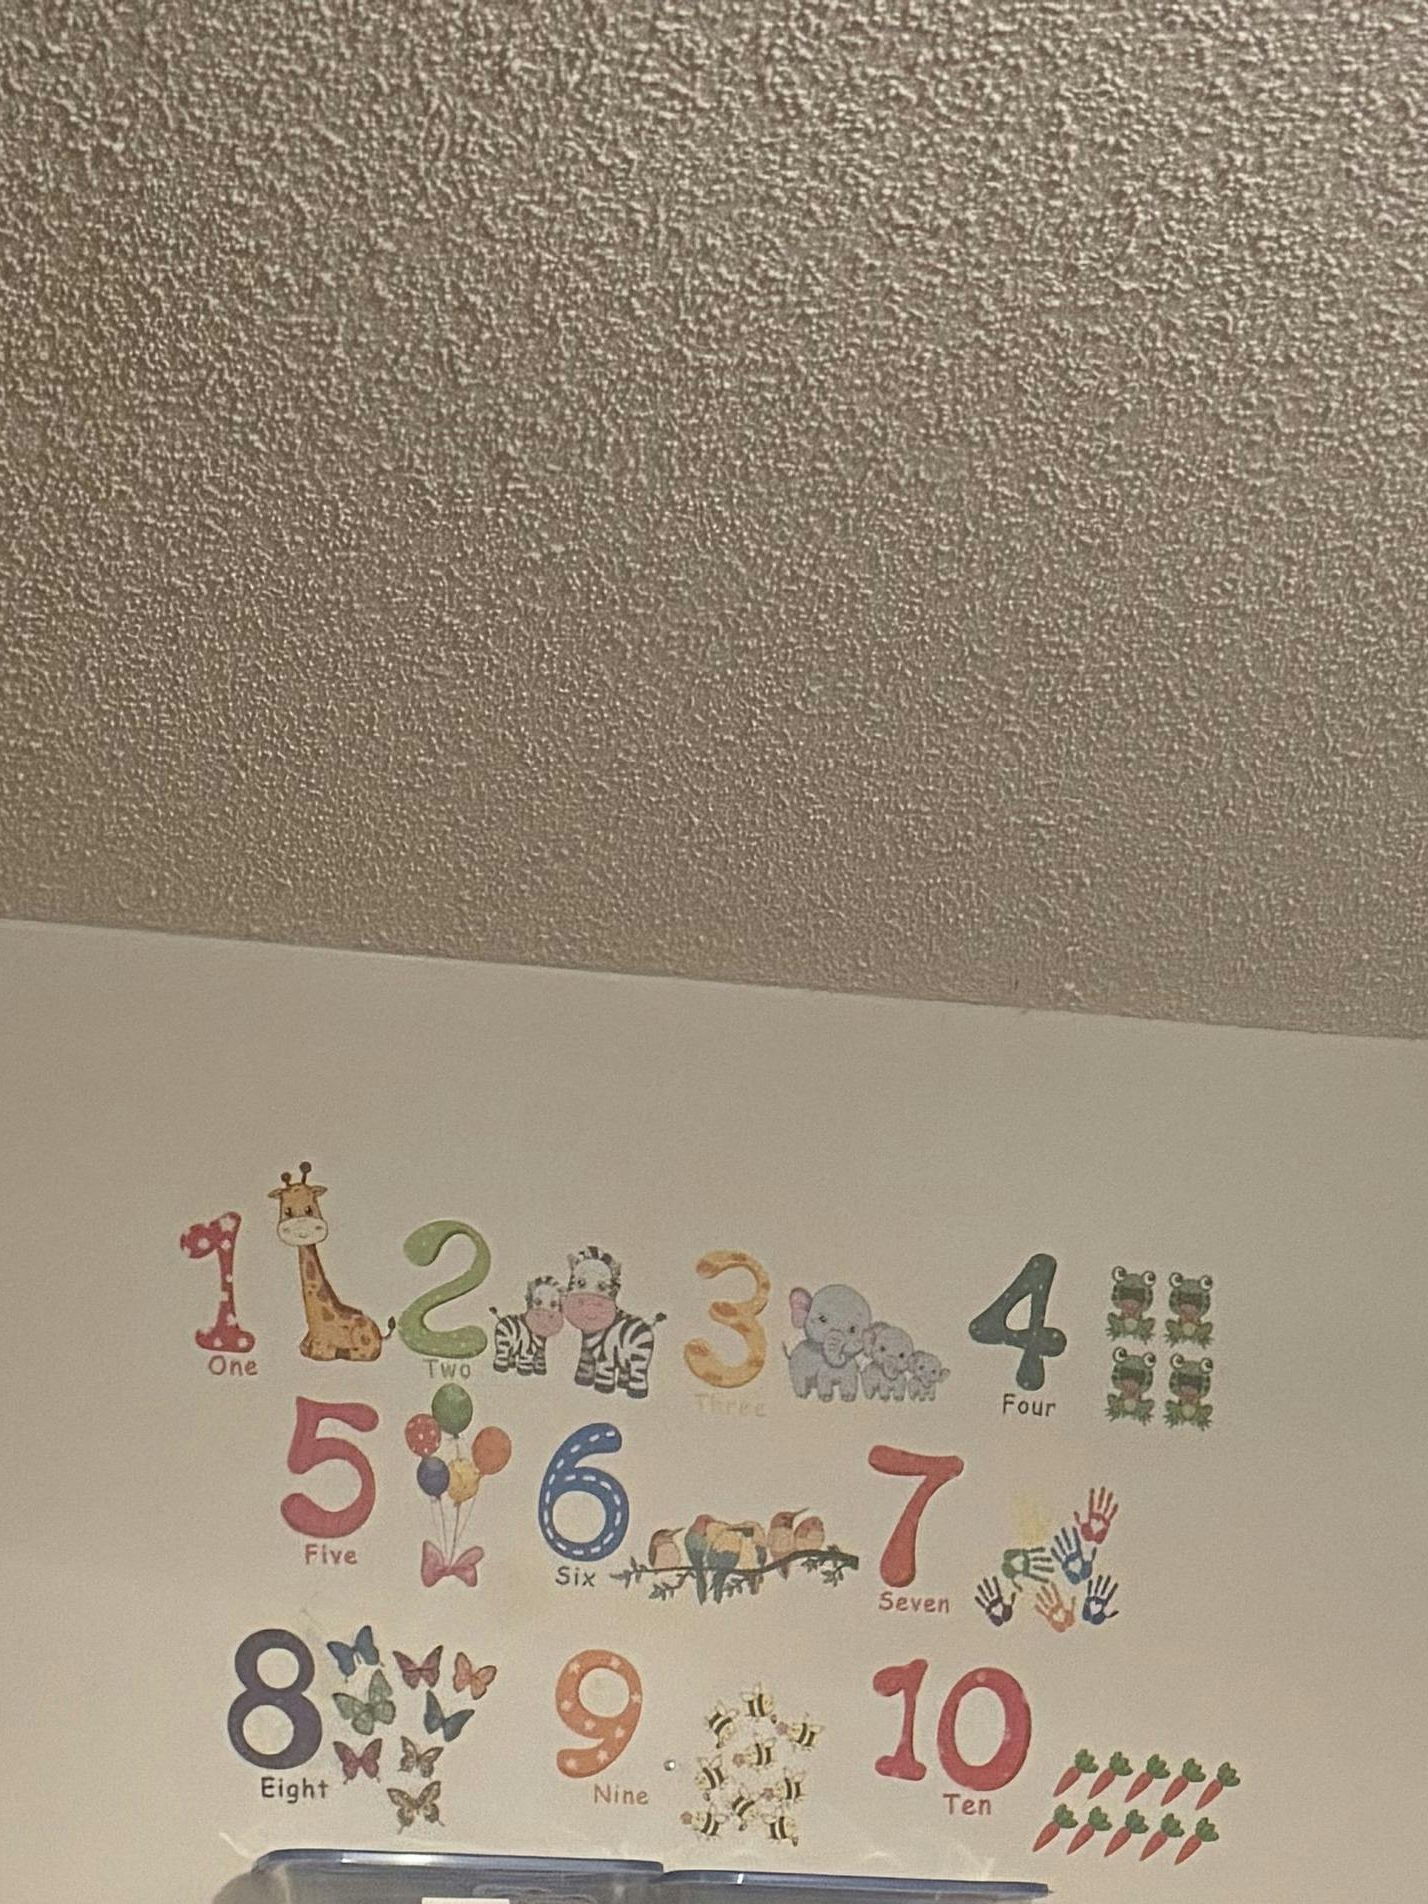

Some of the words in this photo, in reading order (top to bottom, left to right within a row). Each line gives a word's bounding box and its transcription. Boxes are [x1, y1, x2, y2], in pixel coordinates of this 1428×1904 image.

[180, 1211, 256, 1353] 1
[397, 1219, 492, 1360] 2
[683, 1249, 770, 1389] 3
[968, 1253, 1068, 1392] 4
[207, 1355, 259, 1377] One
[421, 1358, 472, 1380] Two
[692, 1393, 768, 1418] Three
[1002, 1393, 1057, 1418] Four
[280, 1396, 380, 1539] 5
[537, 1422, 630, 1562] 6
[304, 1543, 359, 1566] Five
[868, 1445, 965, 1588] 7
[555, 1566, 598, 1588] Six
[878, 1591, 951, 1614] Seven
[227, 1628, 323, 1770] 8
[555, 1649, 644, 1779] 9
[872, 1657, 1032, 1792] 10
[260, 1776, 330, 1804] Eight
[593, 1783, 649, 1806] Nine
[942, 1793, 993, 1816] Ten
